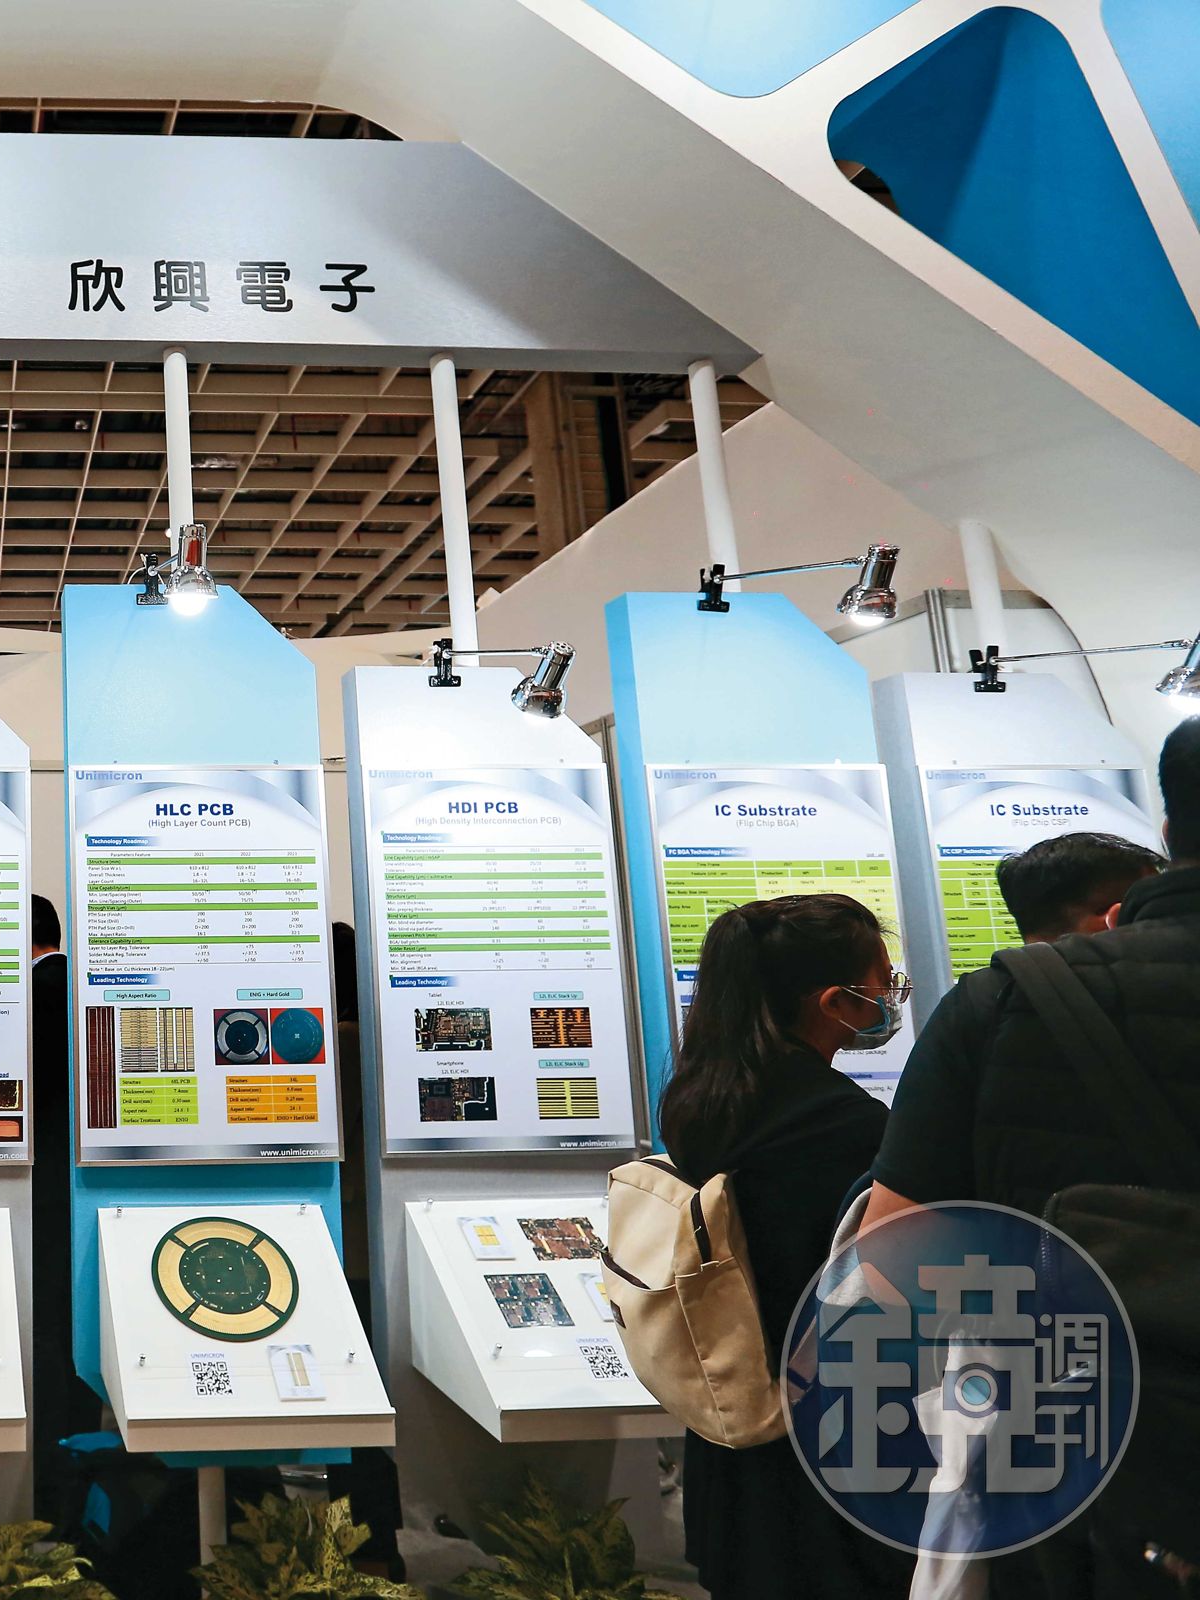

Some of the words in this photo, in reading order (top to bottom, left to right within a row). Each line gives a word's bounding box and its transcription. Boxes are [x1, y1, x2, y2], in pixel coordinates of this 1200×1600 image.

[68, 258, 376, 313] 欣興電子
[75, 770, 143, 781] Unimicron
[368, 769, 433, 779] Unimicron
[654, 770, 717, 779] Unimicron
[926, 771, 986, 780] Unimicron
[155, 803, 192, 816] HLC
[198, 803, 234, 816] PCB
[448, 802, 478, 814] HDI
[485, 802, 519, 814] PCB
[715, 804, 731, 817] IC
[737, 804, 817, 817] Substrate
[990, 804, 1006, 816] IC
[1013, 804, 1089, 816] Substrate
[148, 818, 172, 829] (High
[173, 819, 199, 829] Layer
[200, 819, 227, 827] Count
[229, 818, 251, 828] PCB)
[415, 816, 438, 826] (High
[440, 817, 471, 826] Density
[473, 816, 538, 826] Interconnection
[540, 816, 562, 826] PCB)
[736, 819, 754, 828] (Flip
[756, 819, 776, 828] Chip
[777, 819, 799, 828] BGA)
[1012, 818, 1030, 827] (Flip
[1031, 819, 1049, 827] Chip
